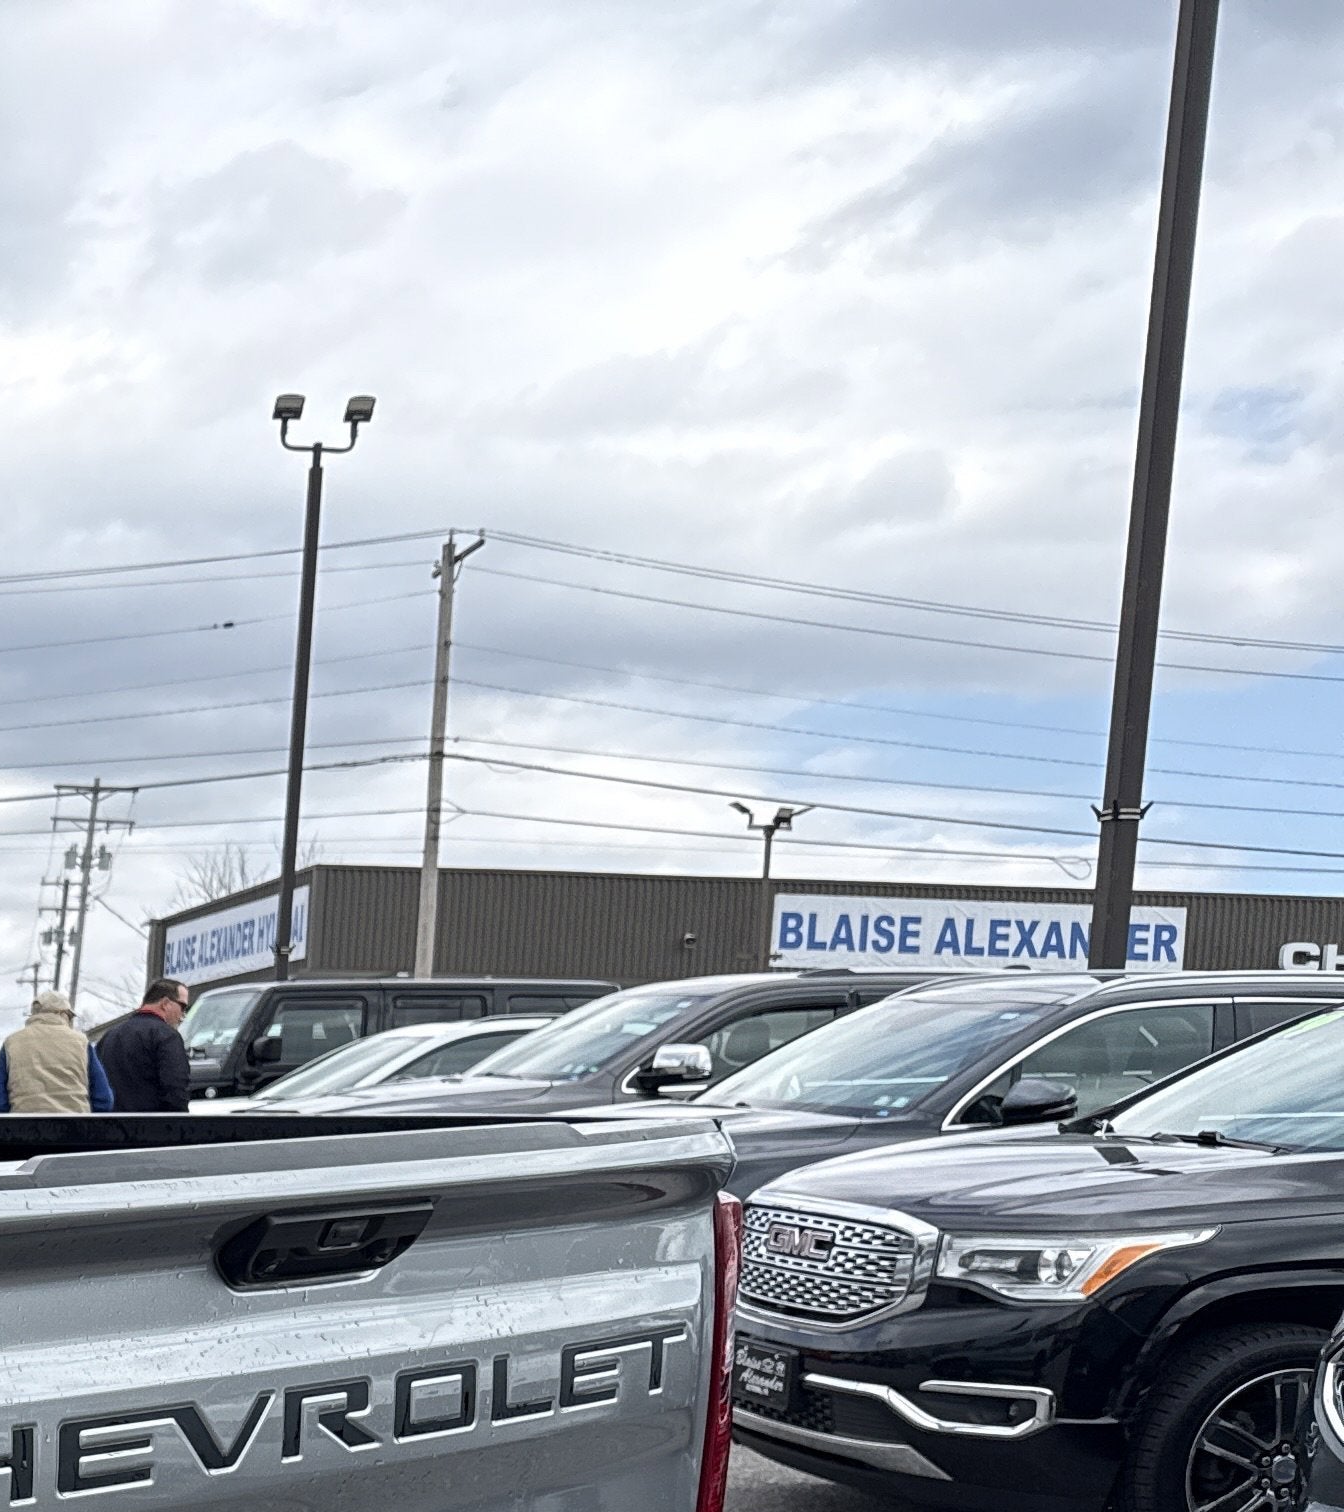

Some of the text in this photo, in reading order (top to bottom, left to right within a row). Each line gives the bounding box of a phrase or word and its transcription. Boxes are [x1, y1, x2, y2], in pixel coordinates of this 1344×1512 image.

[165, 904, 305, 976] BLAISE ALEXANDER HYAI
[779, 912, 1179, 963] BLAISE ALEXANER
[767, 1223, 833, 1262] GMC
